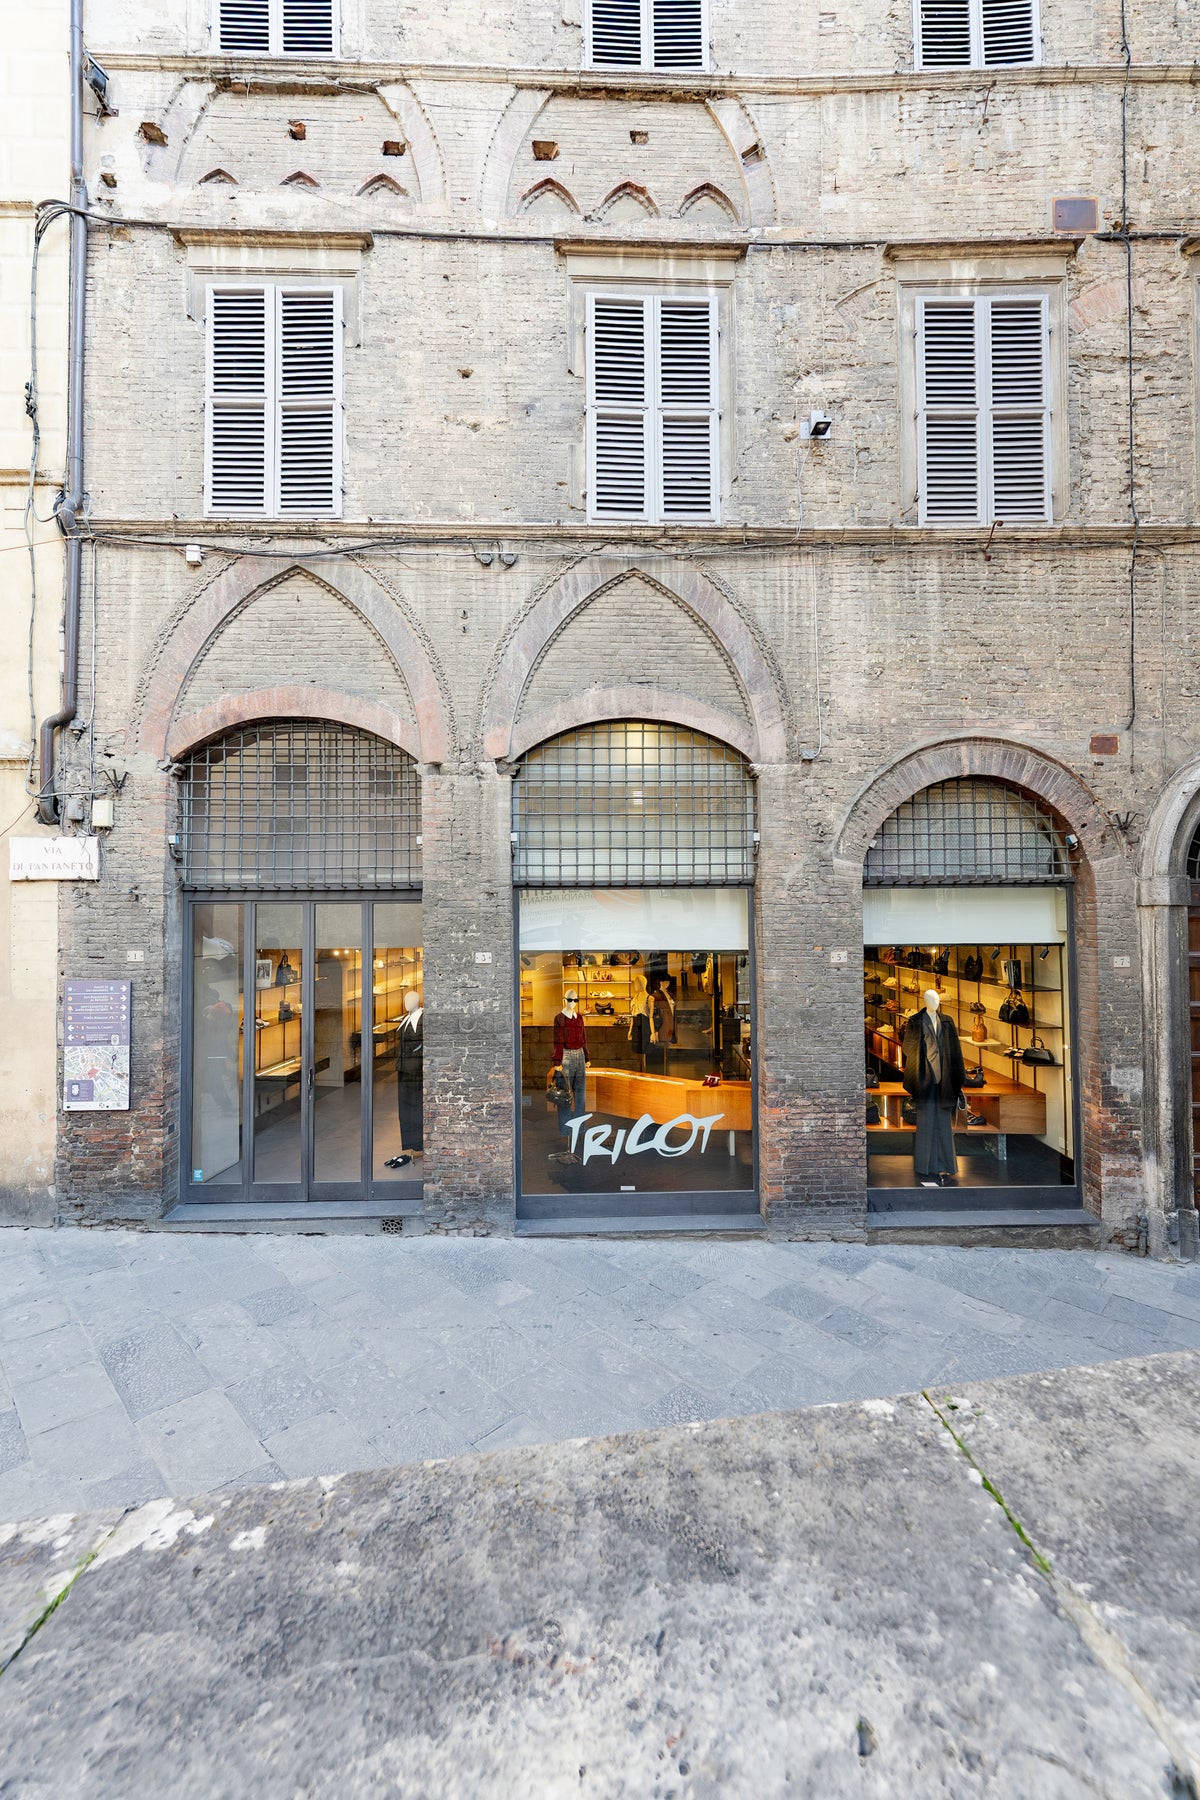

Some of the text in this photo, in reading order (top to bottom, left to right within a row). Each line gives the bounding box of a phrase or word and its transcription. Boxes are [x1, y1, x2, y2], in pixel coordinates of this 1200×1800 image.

[44, 846, 62, 855] VIA
[13, 862, 94, 871] DI PANTANETO
[836, 953, 842, 961] 5
[565, 1113, 725, 1166] TRICOT
